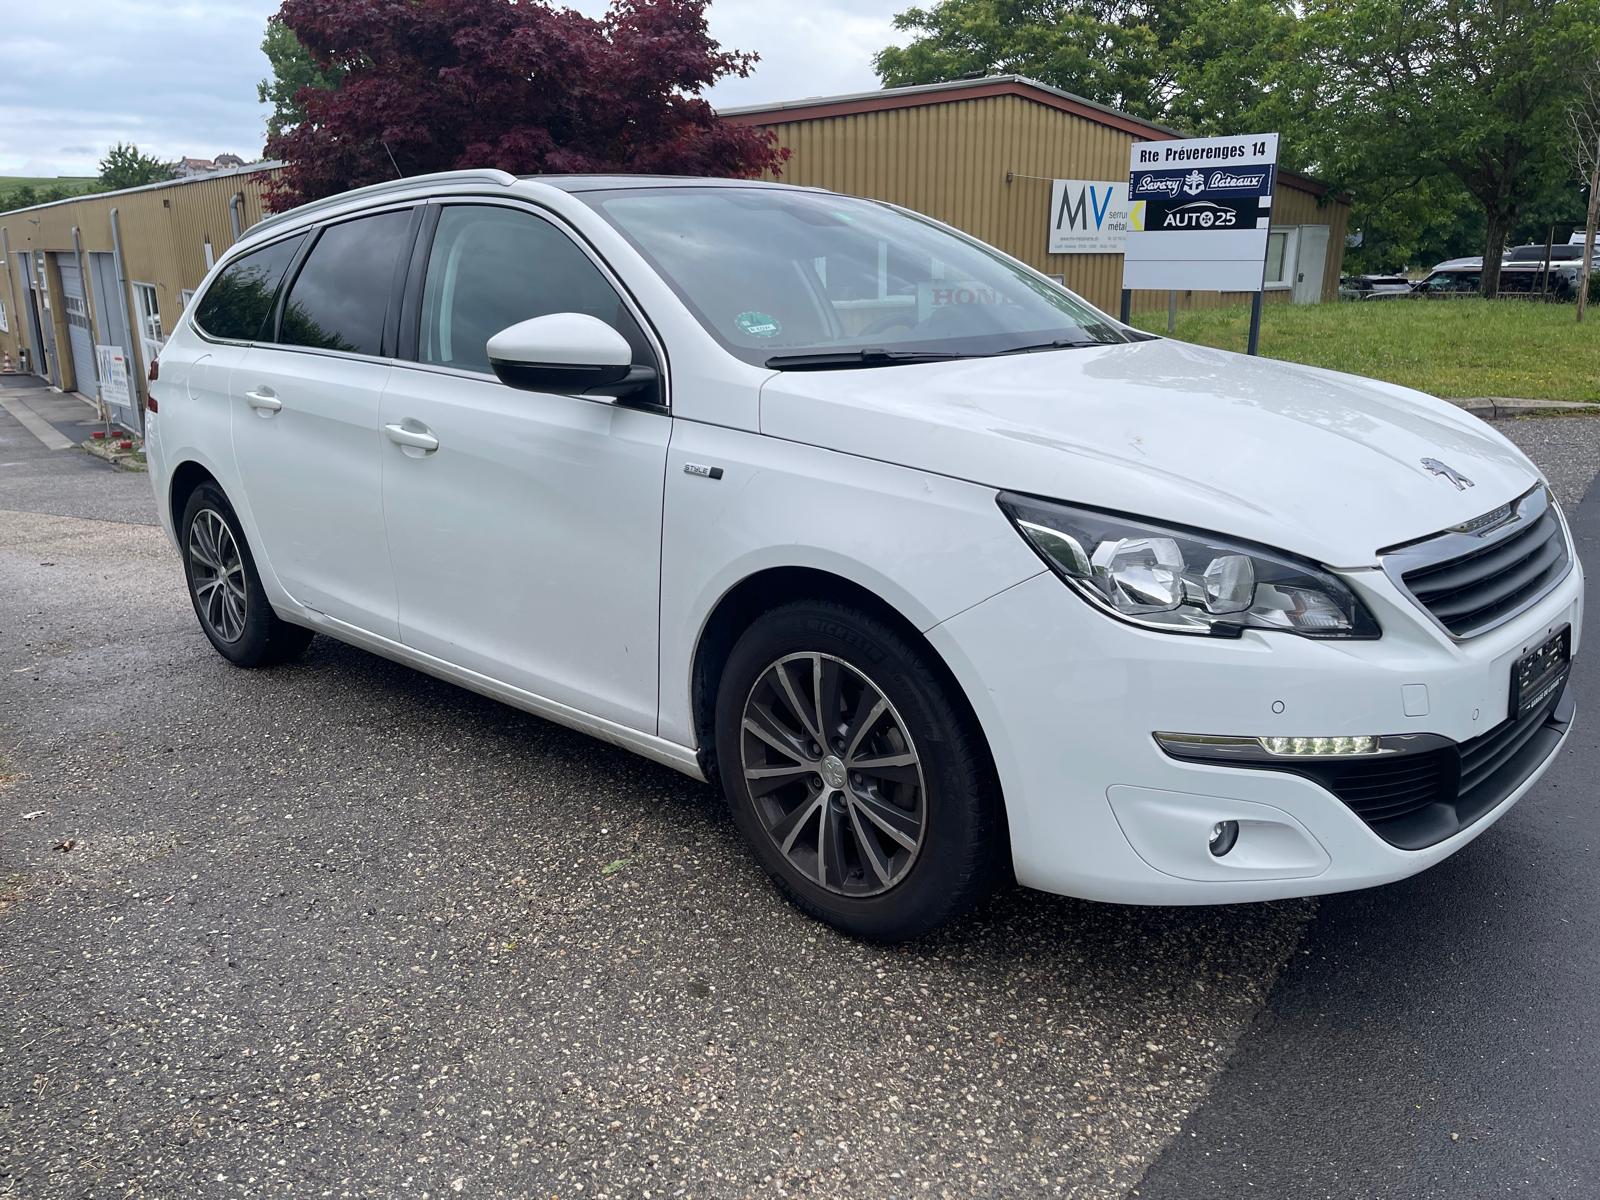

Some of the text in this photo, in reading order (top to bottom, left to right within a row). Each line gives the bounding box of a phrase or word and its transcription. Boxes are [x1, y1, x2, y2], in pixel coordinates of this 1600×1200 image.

[1140, 141, 1266, 163] Rte Préverenges 14
[1137, 175, 1183, 196] Savary
[1207, 172, 1263, 189] Bateaux
[1056, 184, 1114, 232] MV
[931, 288, 1011, 305] HON
[684, 464, 709, 475] STYLE
